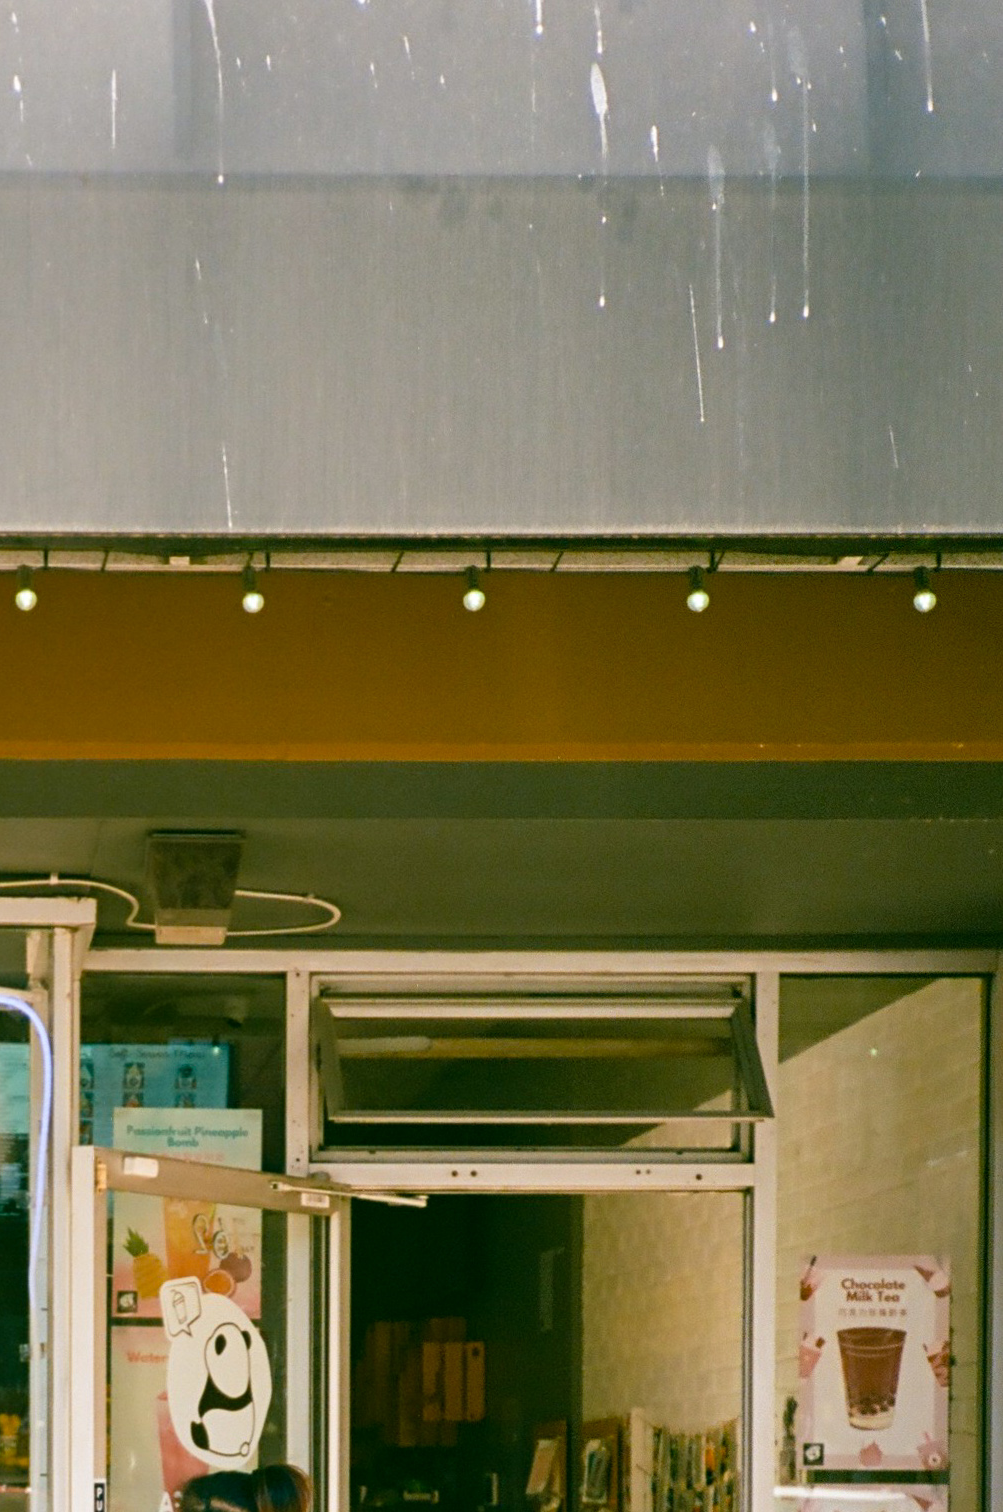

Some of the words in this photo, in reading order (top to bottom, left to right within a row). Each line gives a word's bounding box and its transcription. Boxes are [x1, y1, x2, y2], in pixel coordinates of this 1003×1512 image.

[841, 1277, 906, 1290] Chocolate
[846, 1291, 873, 1301] Milk
[877, 1290, 900, 1302] Tea
